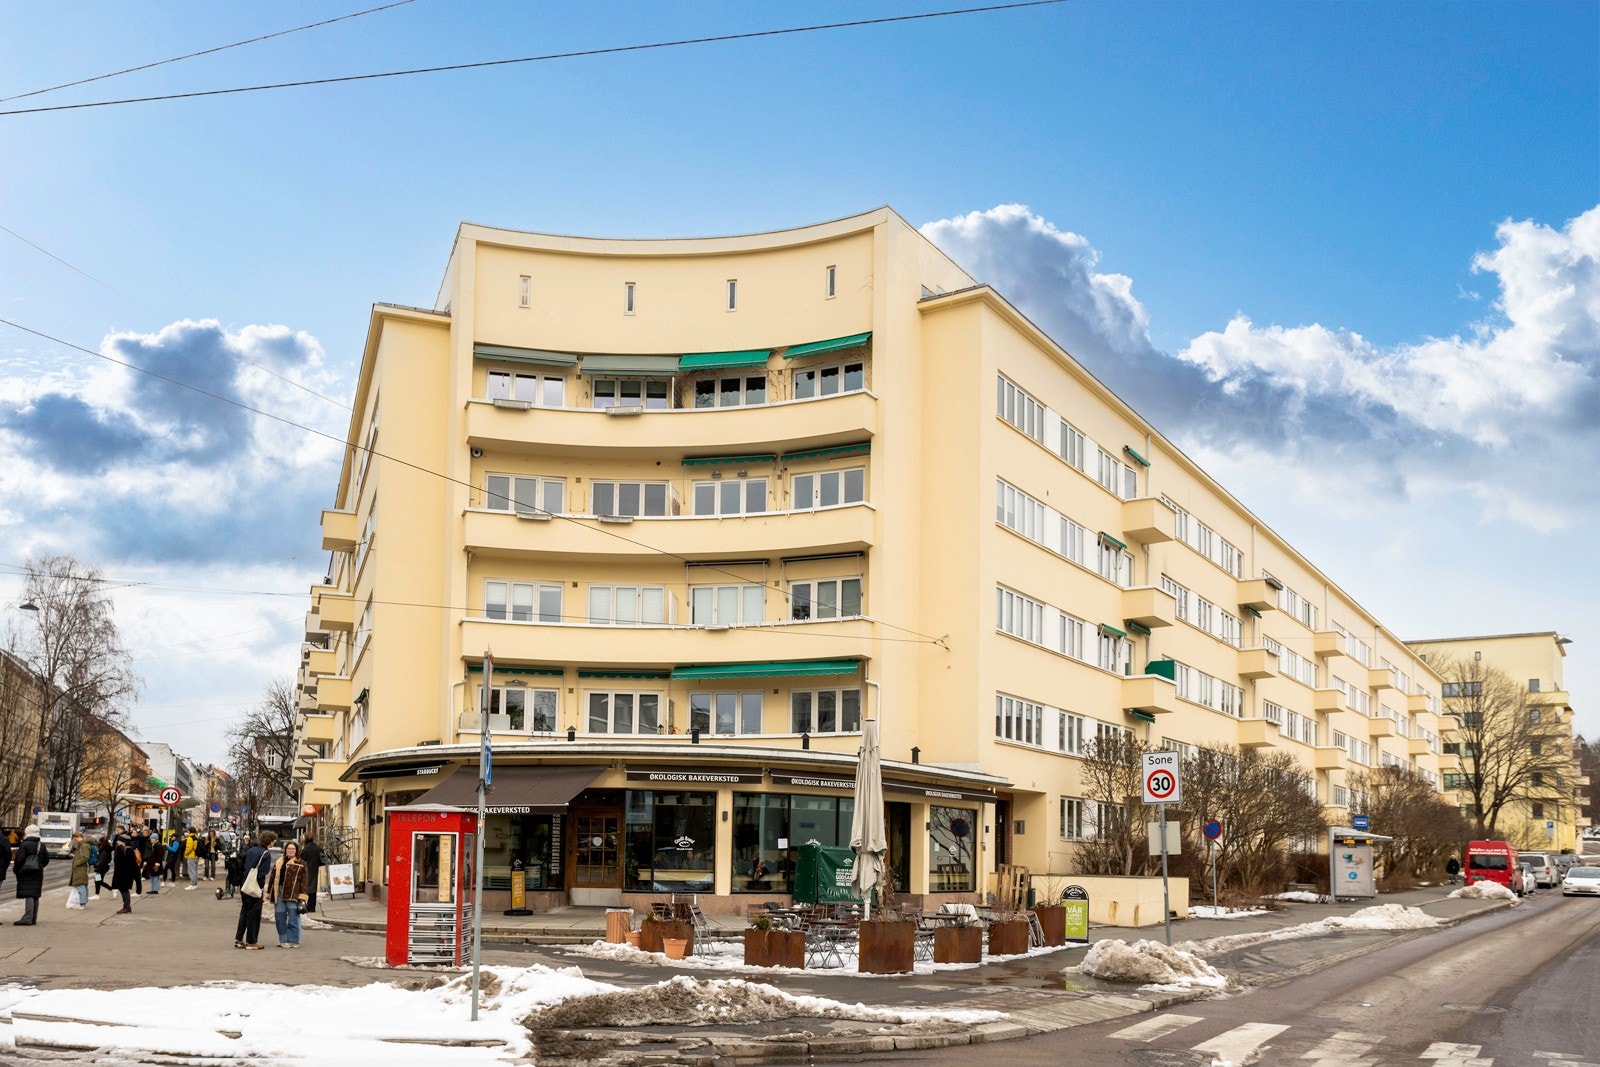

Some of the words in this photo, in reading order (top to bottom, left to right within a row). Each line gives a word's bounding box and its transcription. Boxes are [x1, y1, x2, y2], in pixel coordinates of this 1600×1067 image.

[1148, 755, 1173, 765] Sone
[416, 767, 439, 776] STARBUCKS
[649, 773, 687, 781] ØKOLOGISK
[688, 774, 740, 783] BAKEVERKSTED
[791, 778, 820, 786] ØKOLOGISK
[1152, 776, 1171, 791] 30
[163, 791, 178, 801] 40
[484, 806, 531, 814] AKEVERKSTED
[397, 813, 436, 823] TELEFON
[1067, 904, 1083, 914] VÅR
